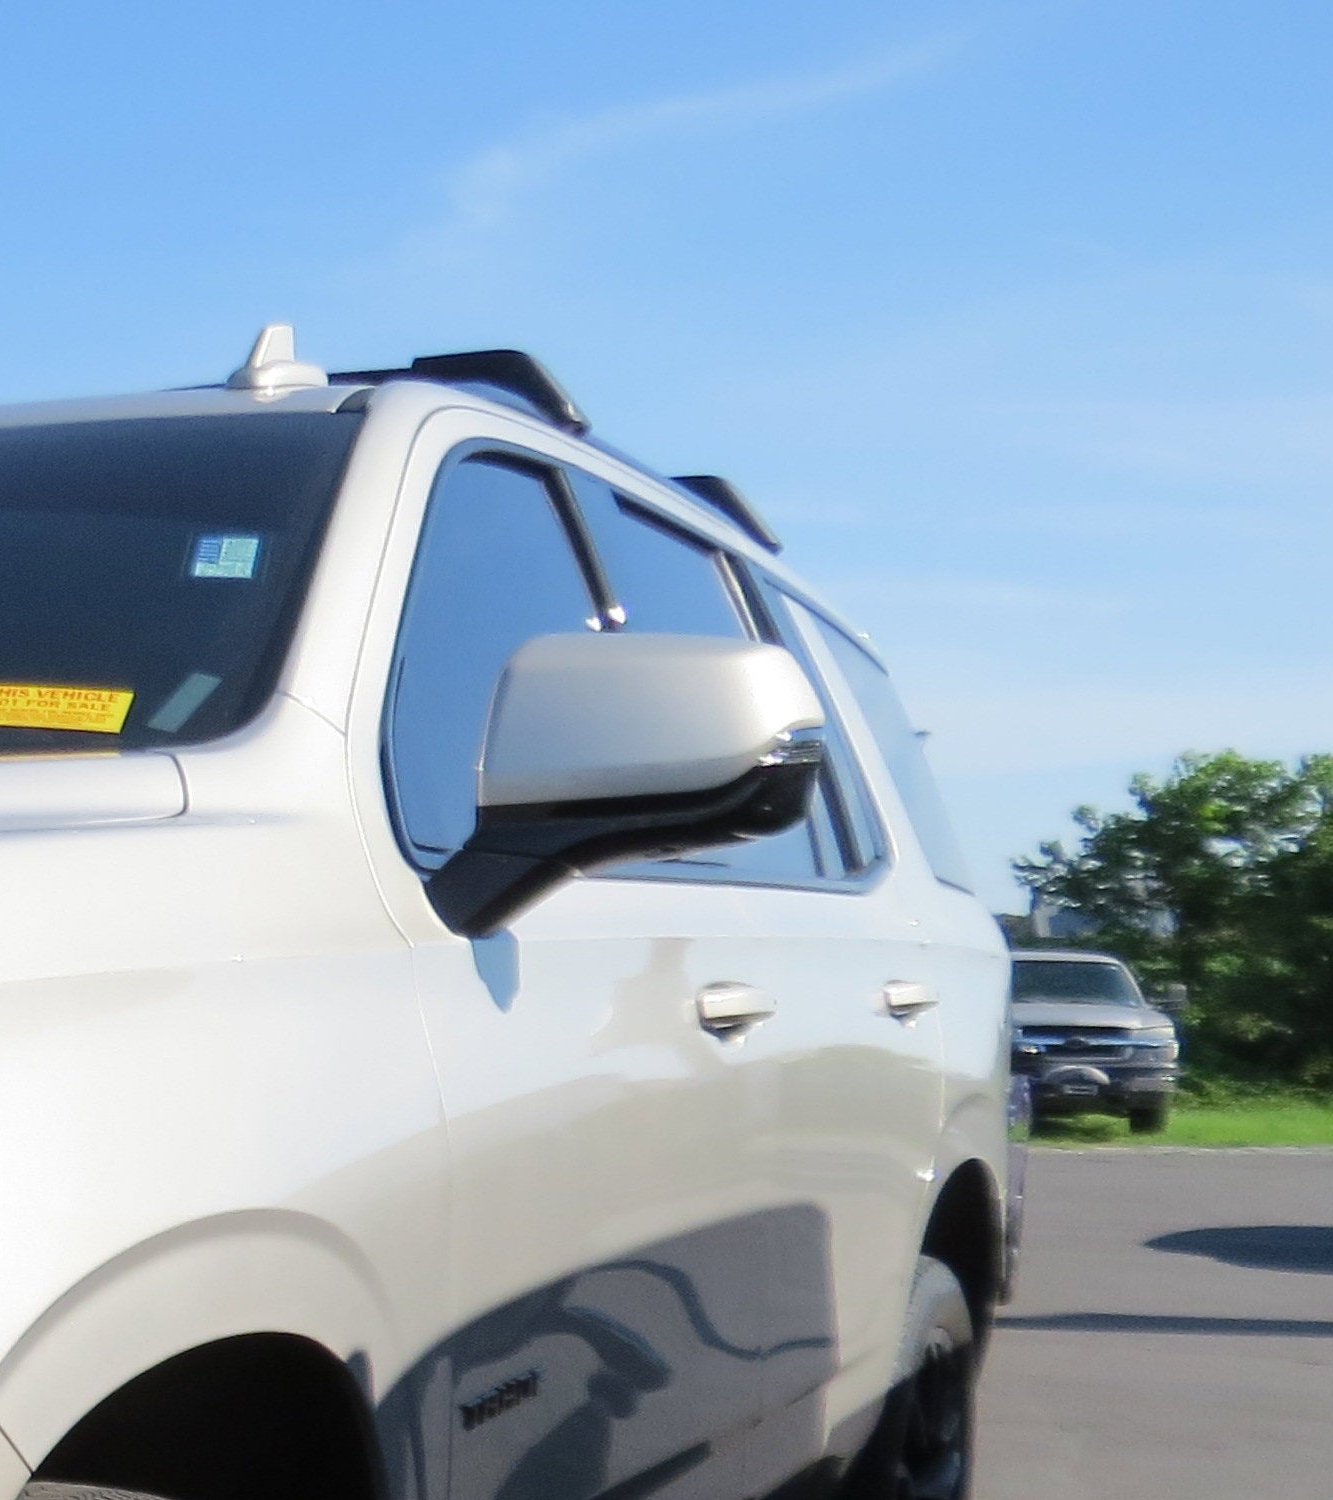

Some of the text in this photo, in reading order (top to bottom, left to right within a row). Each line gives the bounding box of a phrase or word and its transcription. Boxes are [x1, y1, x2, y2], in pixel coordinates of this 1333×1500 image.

[37, 689, 119, 703] VEHICLE
[25, 700, 61, 709] FOR
[67, 701, 111, 711] SALE
